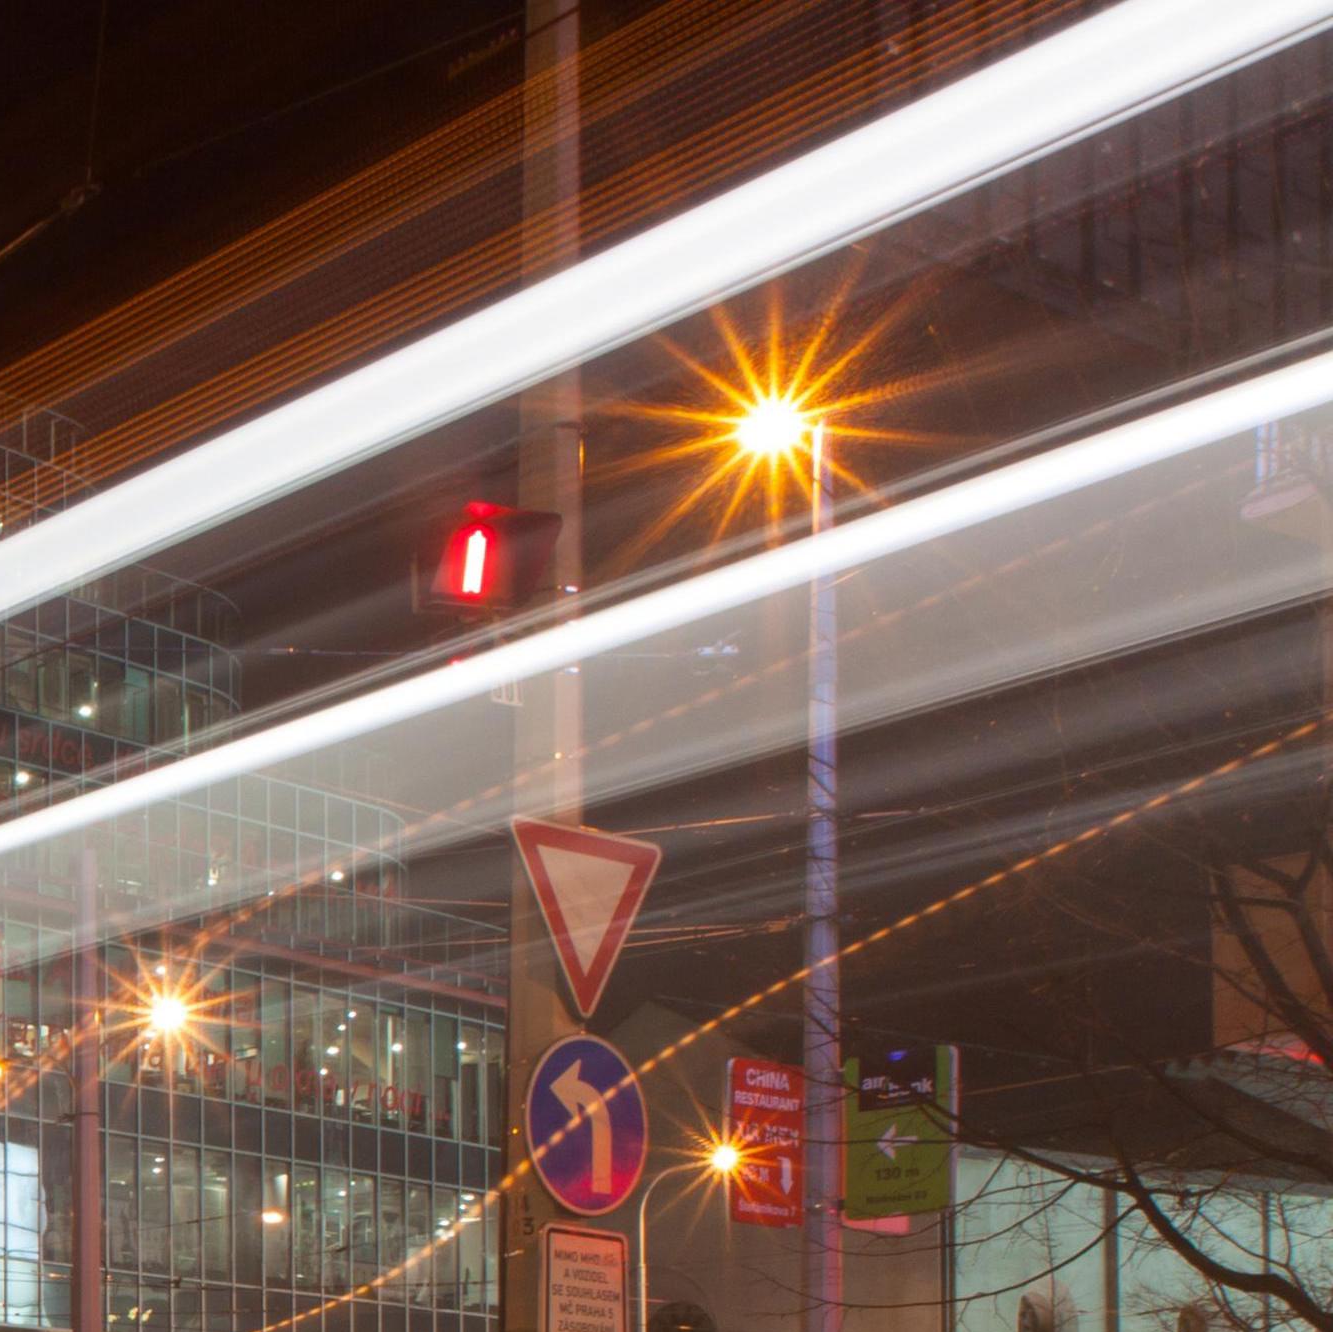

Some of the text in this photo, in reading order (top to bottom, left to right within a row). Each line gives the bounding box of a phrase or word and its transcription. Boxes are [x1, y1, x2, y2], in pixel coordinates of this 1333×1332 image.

[746, 1068, 790, 1091] CHINA
[734, 1090, 800, 1112] RESTAURANT
[563, 1268, 609, 1285] A VOZIDEL
[552, 1284, 620, 1302] SE SOUHLASEM
[575, 1303, 606, 1318] PRAHA
